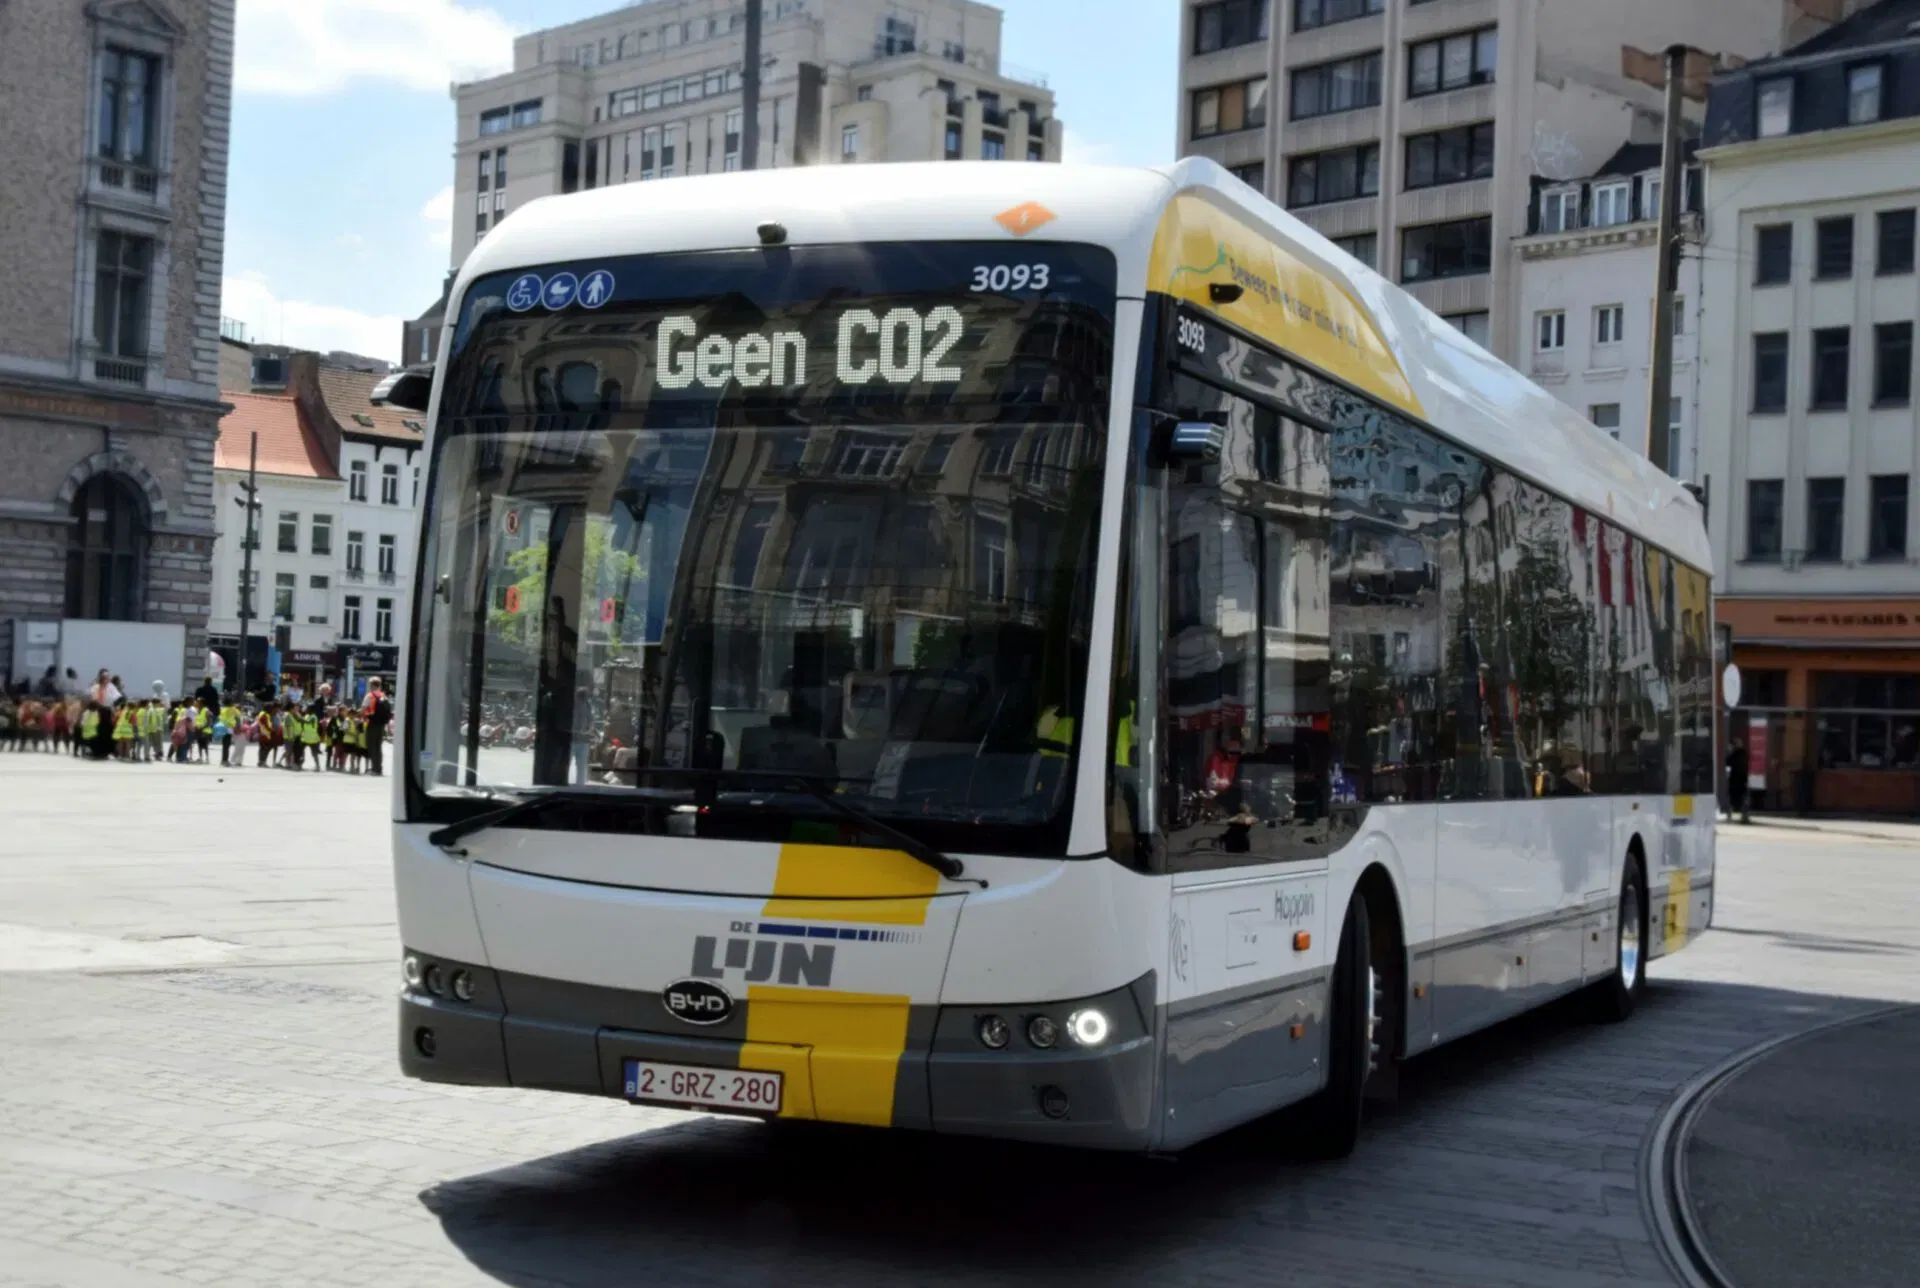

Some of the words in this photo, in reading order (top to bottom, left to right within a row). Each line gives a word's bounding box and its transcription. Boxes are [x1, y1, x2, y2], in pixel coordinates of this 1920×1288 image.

[970, 263, 1050, 291] 3093
[655, 315, 806, 389] Geen
[836, 306, 964, 384] CO2
[1177, 315, 1205, 353] 3093
[1274, 884, 1315, 927] Hoppin
[730, 920, 753, 933] DE
[669, 994, 725, 1012] BYD
